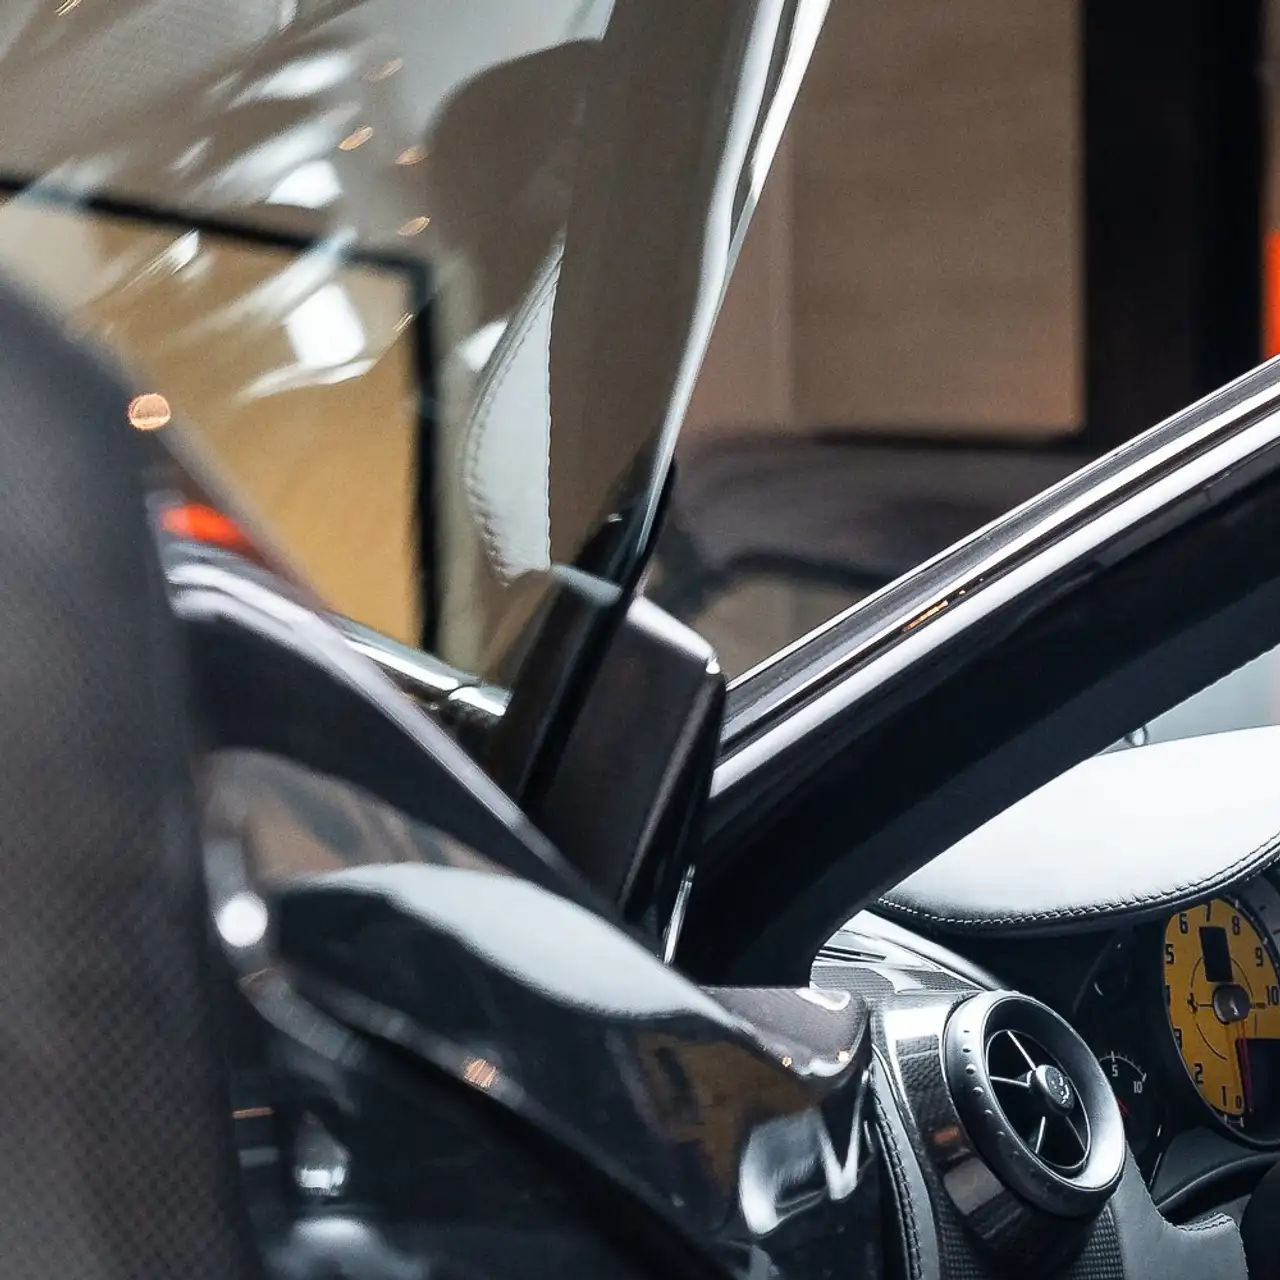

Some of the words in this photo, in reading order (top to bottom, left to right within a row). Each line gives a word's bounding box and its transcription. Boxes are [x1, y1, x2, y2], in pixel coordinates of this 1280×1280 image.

[1204, 901, 1212, 922] 7
[1179, 913, 1189, 934] 6
[1231, 915, 1241, 936] 8
[1165, 944, 1175, 965] 5
[1254, 947, 1264, 967] 9
[1266, 985, 1280, 1006] 10
[1111, 1064, 1119, 1077] 5
[1193, 1063, 1204, 1084] 2
[1132, 1080, 1143, 1094] 10
[1221, 1086, 1228, 1106] 1
[1235, 1095, 1242, 1109] 0
